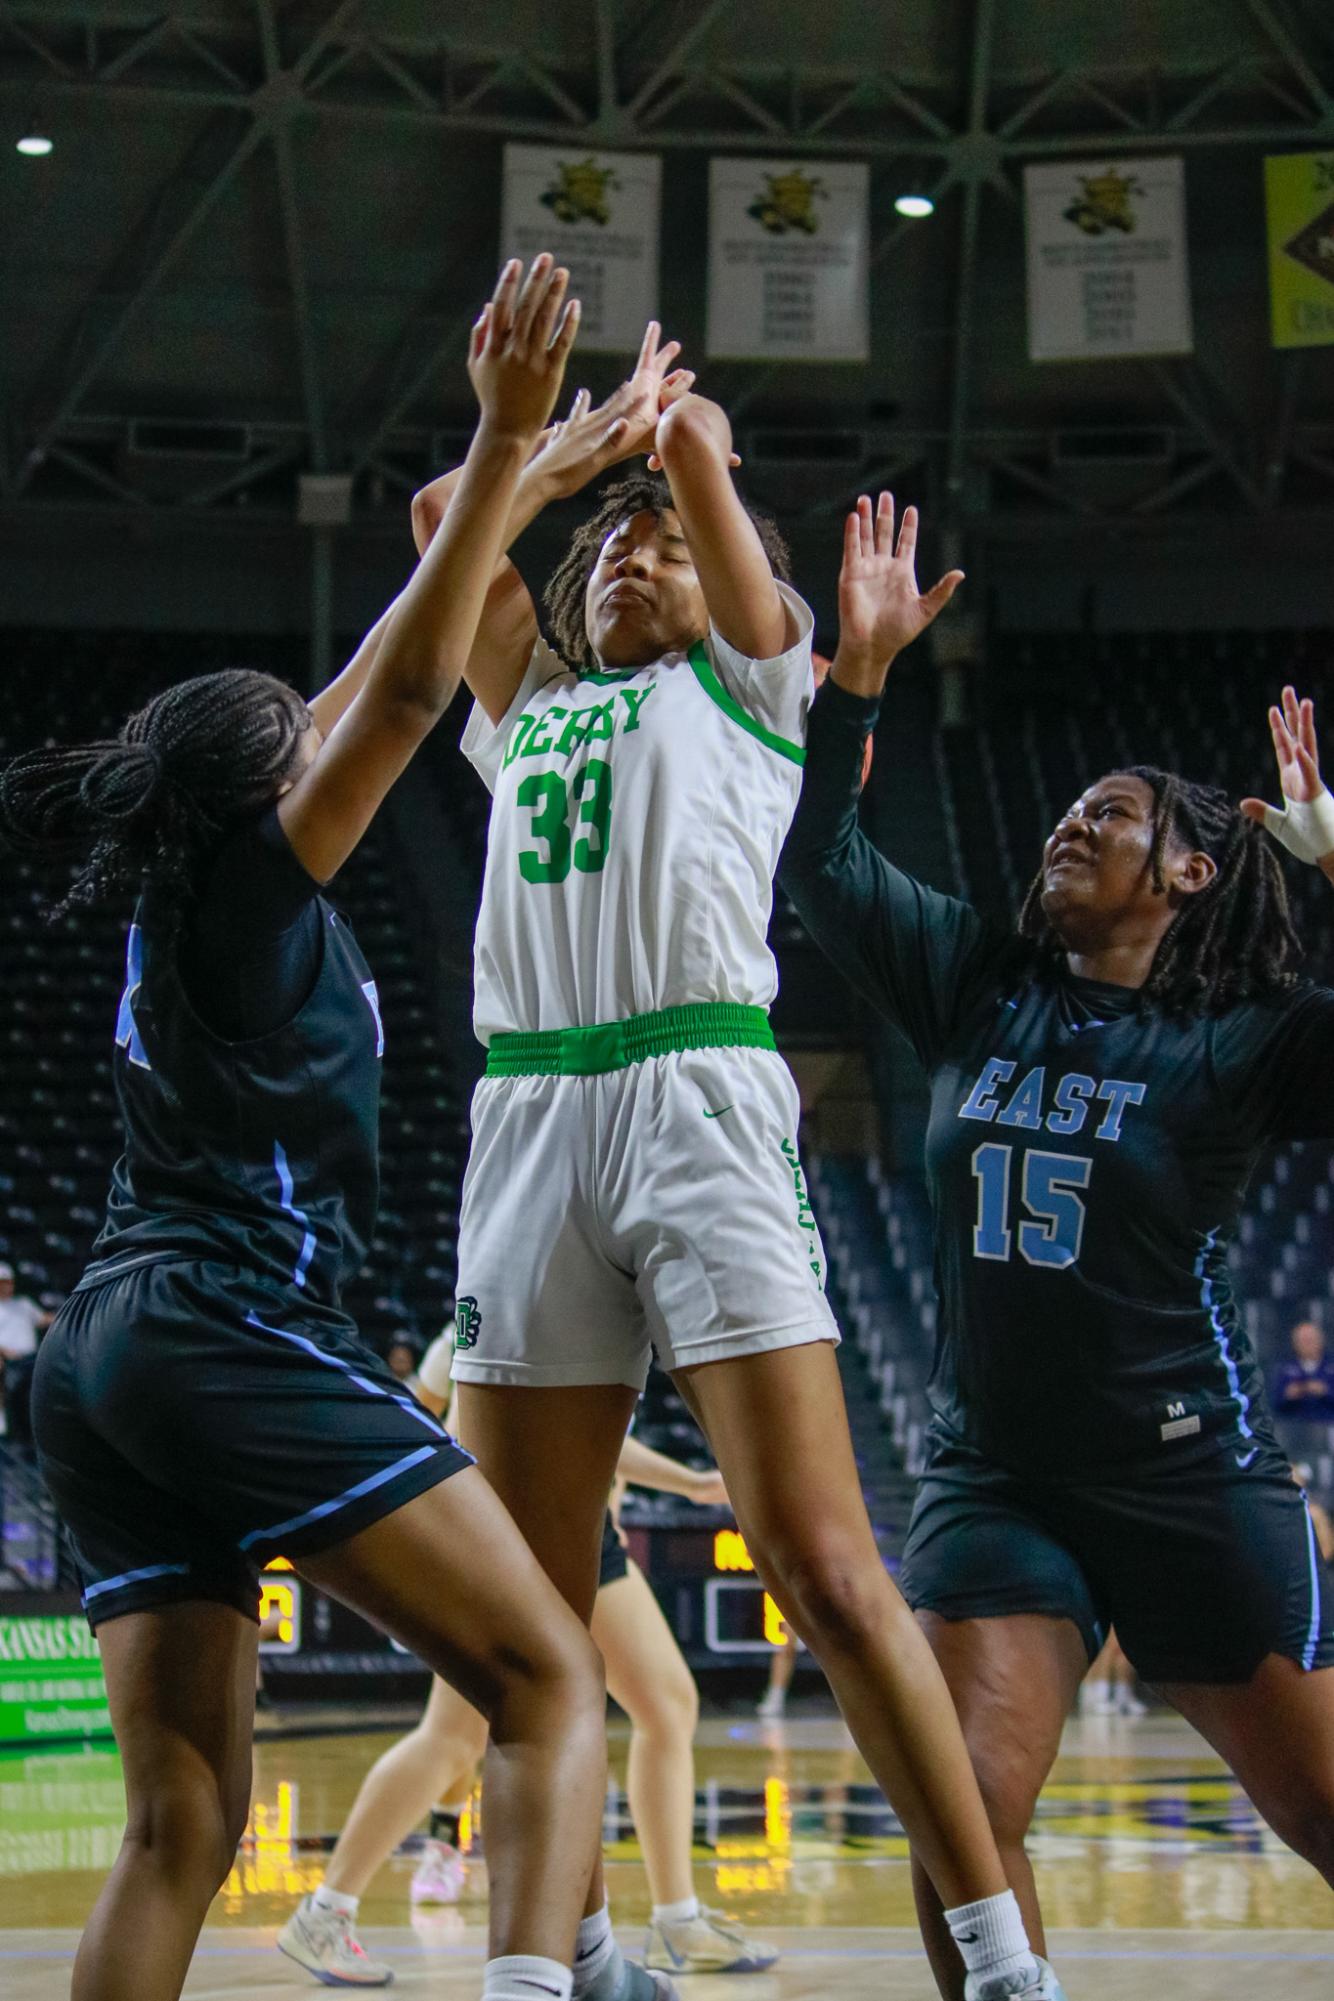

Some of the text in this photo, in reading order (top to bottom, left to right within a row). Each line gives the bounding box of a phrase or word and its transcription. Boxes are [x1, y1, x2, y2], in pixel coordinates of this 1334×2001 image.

[517, 758, 613, 884] 33
[958, 1057, 1147, 1141] EAST
[971, 1142, 1093, 1270] 15
[1167, 1401, 1186, 1419] M
